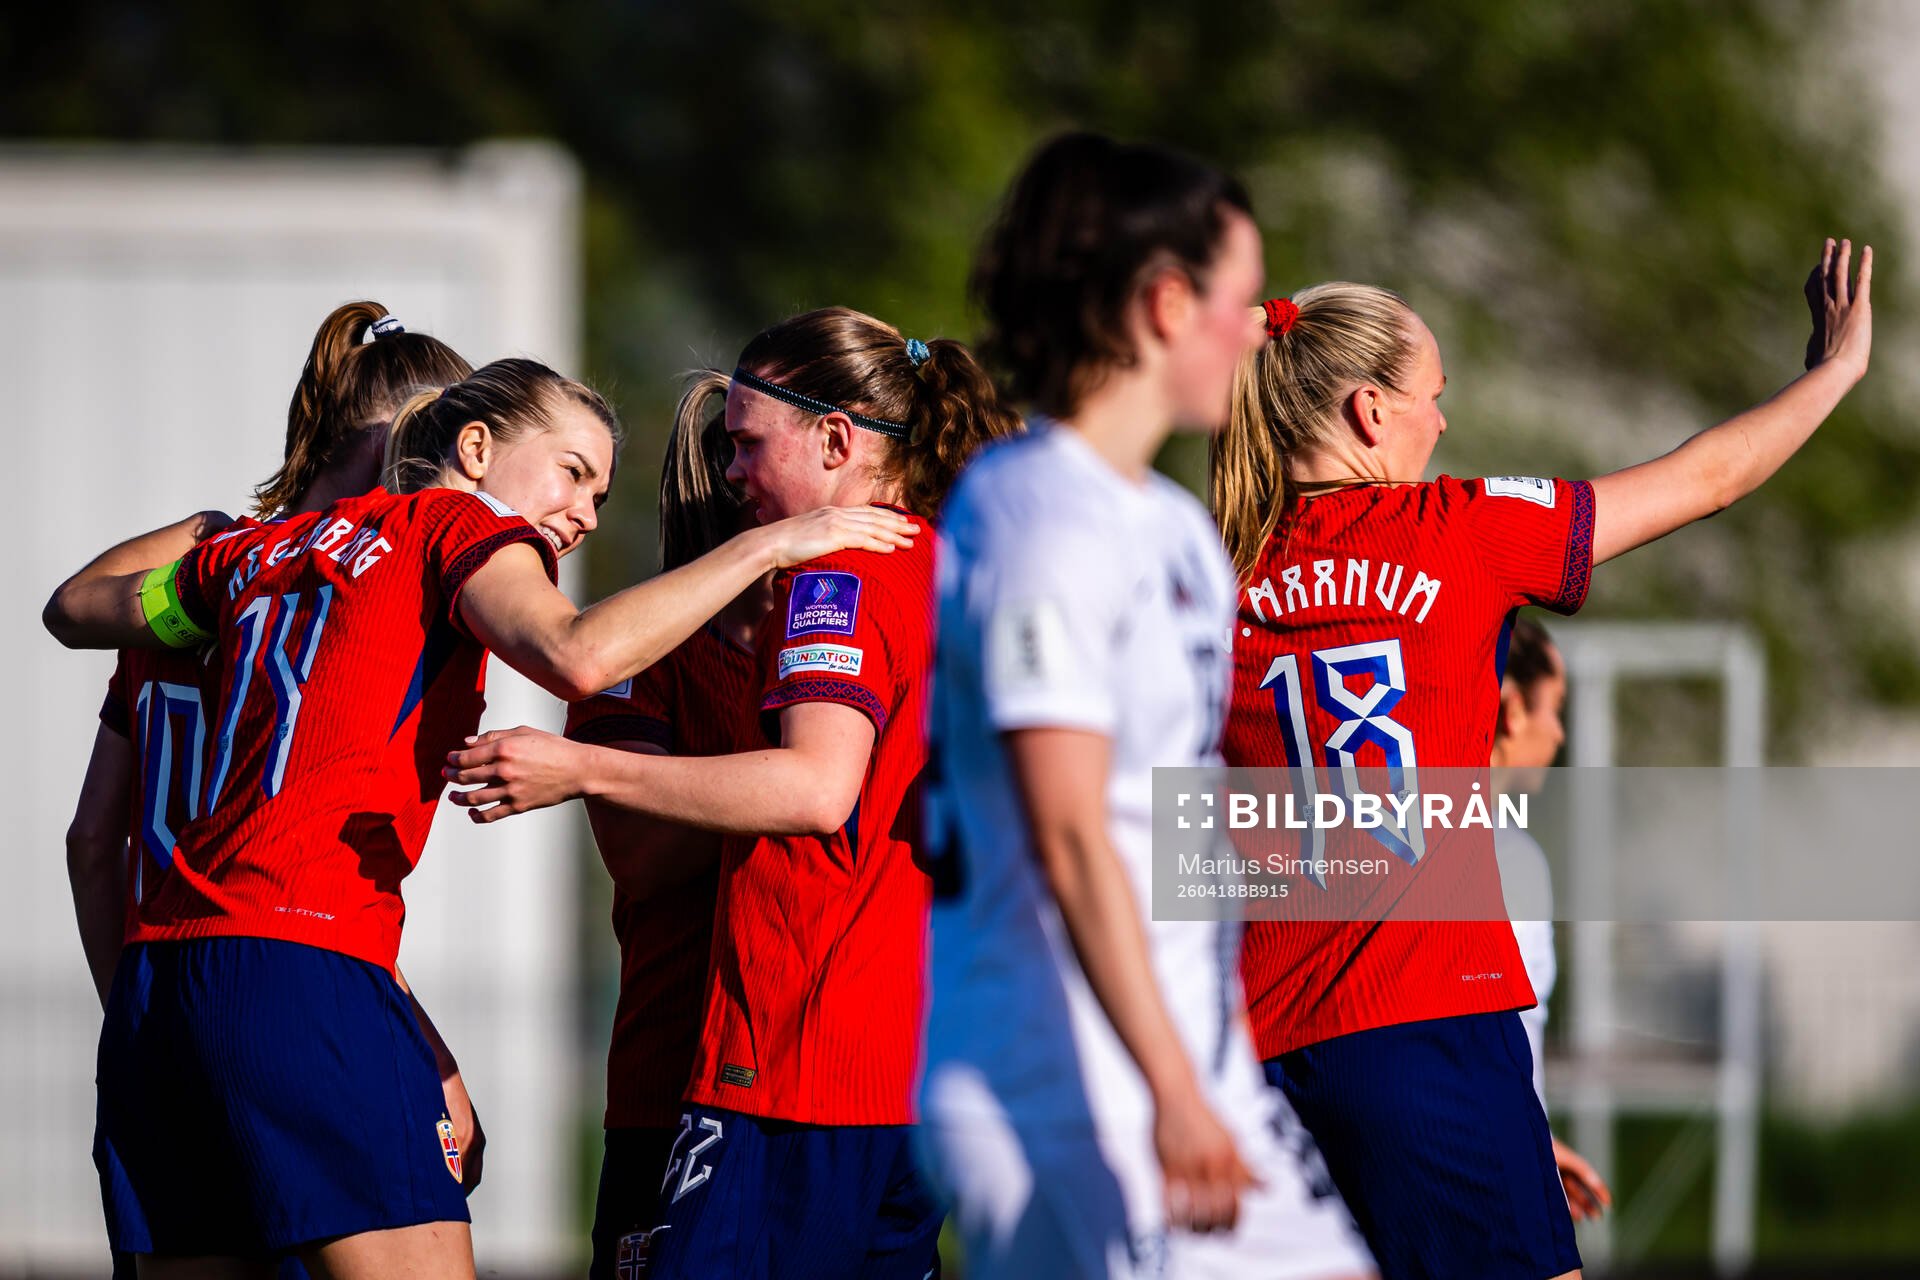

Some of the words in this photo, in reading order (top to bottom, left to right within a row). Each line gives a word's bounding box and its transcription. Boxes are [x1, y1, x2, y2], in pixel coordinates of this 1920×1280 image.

[792, 617, 849, 629] QUALIFIERS
[794, 610, 849, 622] EUROPEAN
[207, 583, 334, 817] 14
[1259, 637, 1427, 892] 18
[660, 1113, 723, 1205] 22
